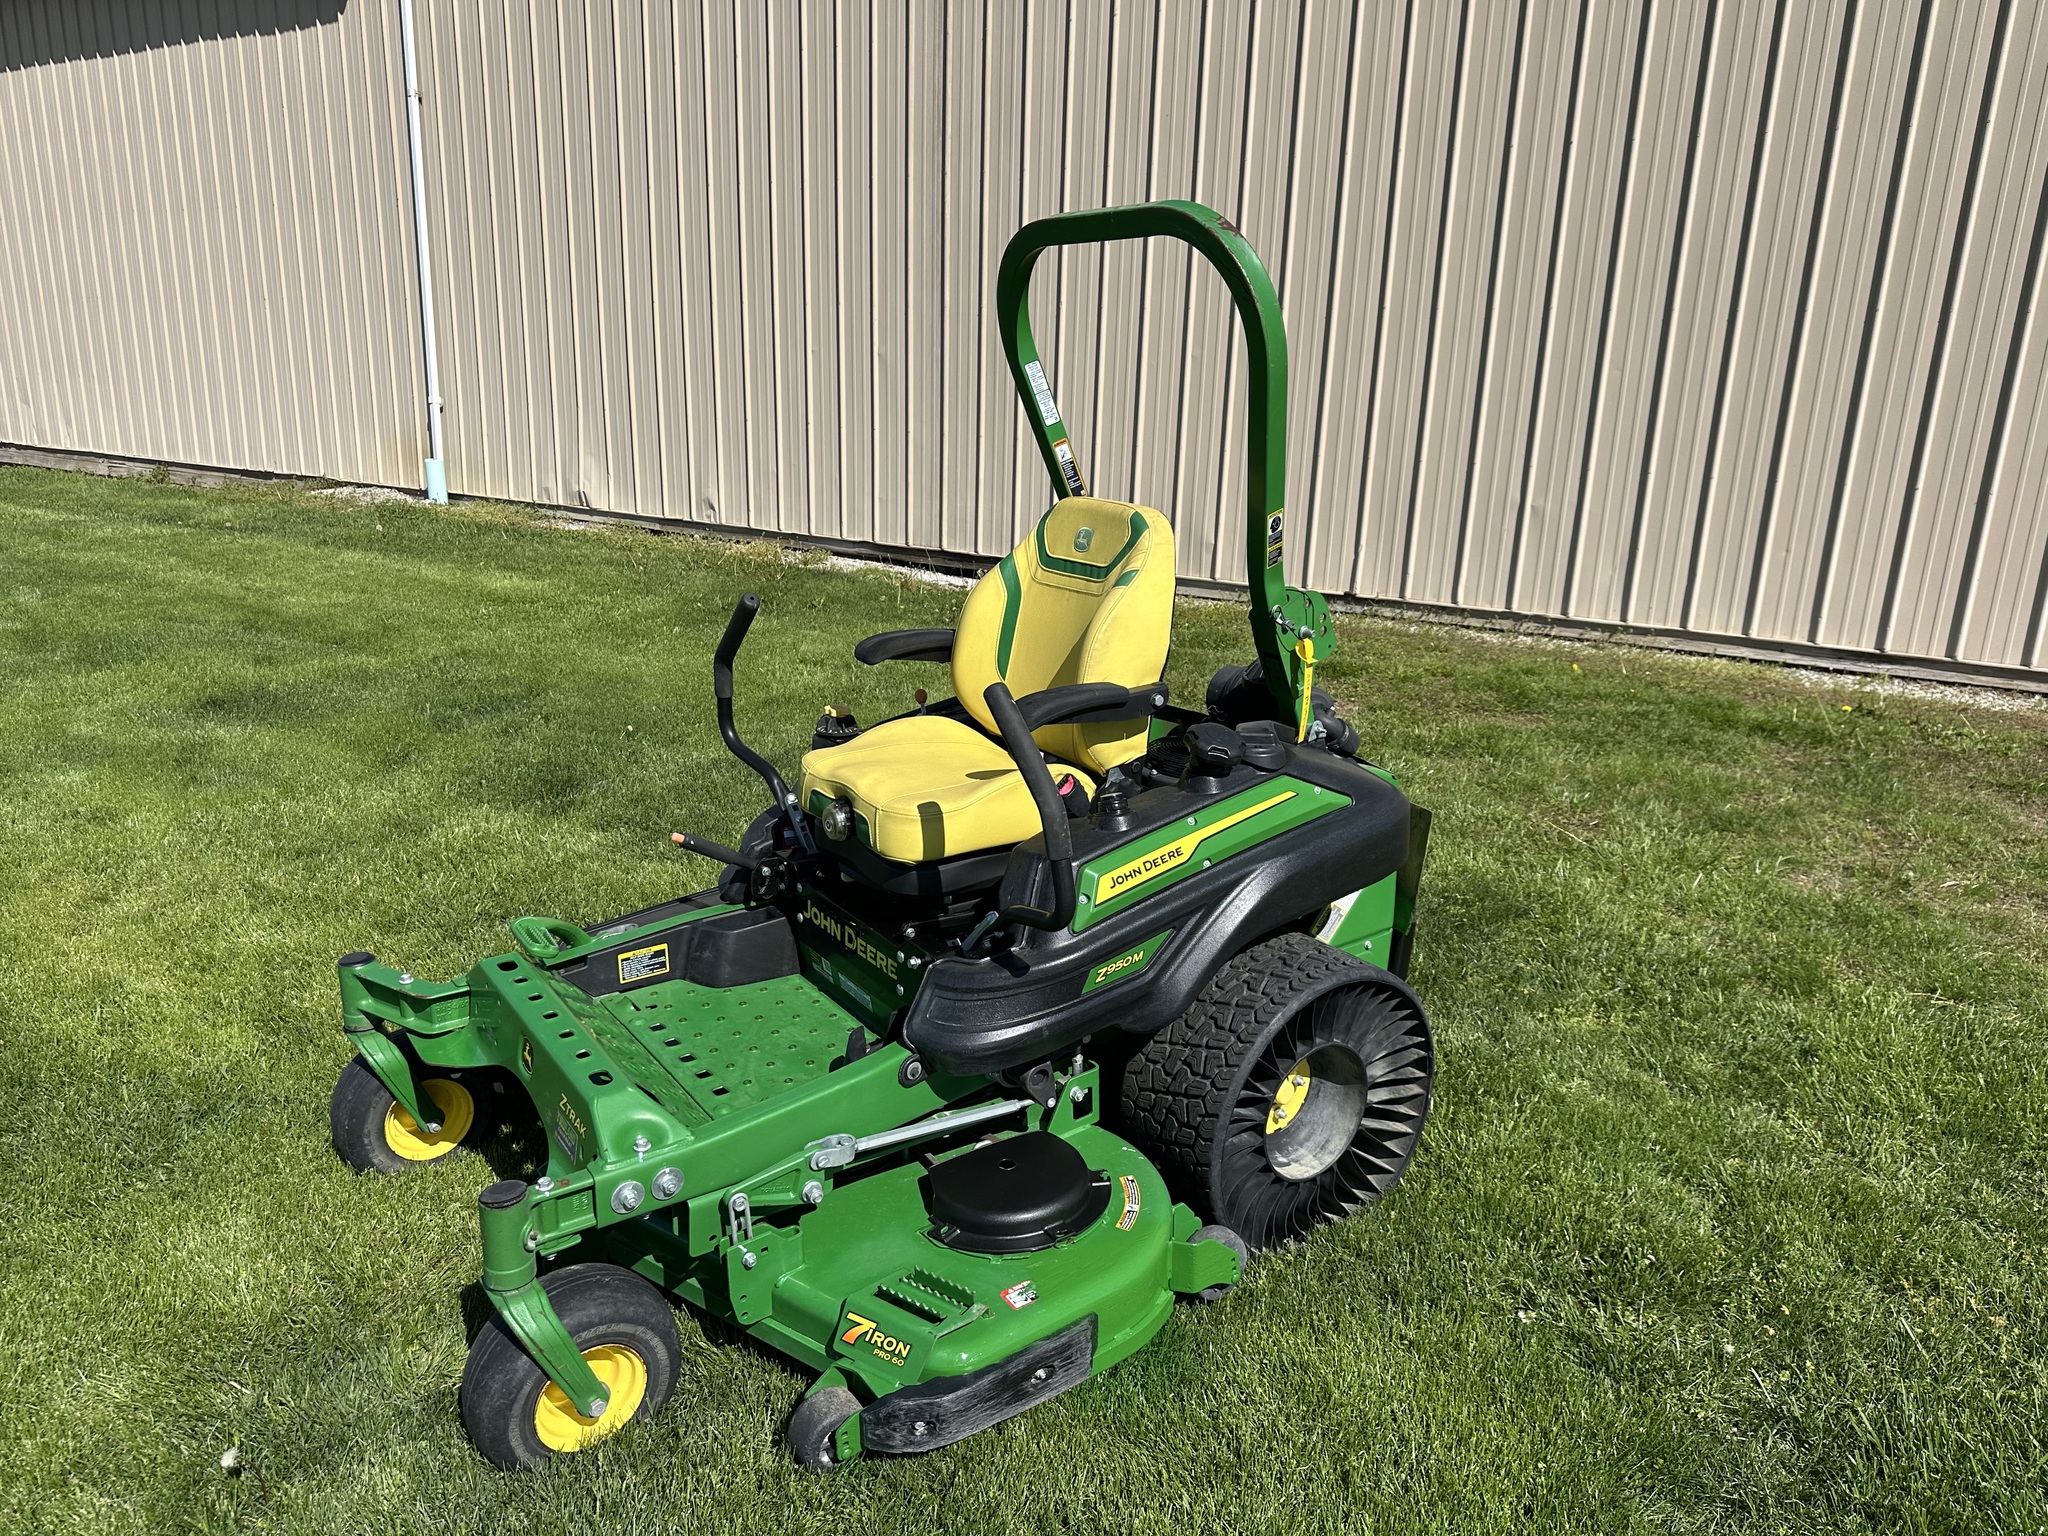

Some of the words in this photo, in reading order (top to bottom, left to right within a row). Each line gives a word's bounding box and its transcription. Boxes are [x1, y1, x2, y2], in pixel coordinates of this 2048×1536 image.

[1110, 867, 1142, 889] JOHN
[1143, 847, 1183, 872] DEERE
[803, 900, 841, 941] JOHN
[844, 926, 898, 980] DEERE
[1095, 950, 1144, 983] Z950M
[559, 1092, 587, 1139] ZTRAK
[873, 1348, 891, 1361] PRO
[892, 1357, 904, 1367] 60
